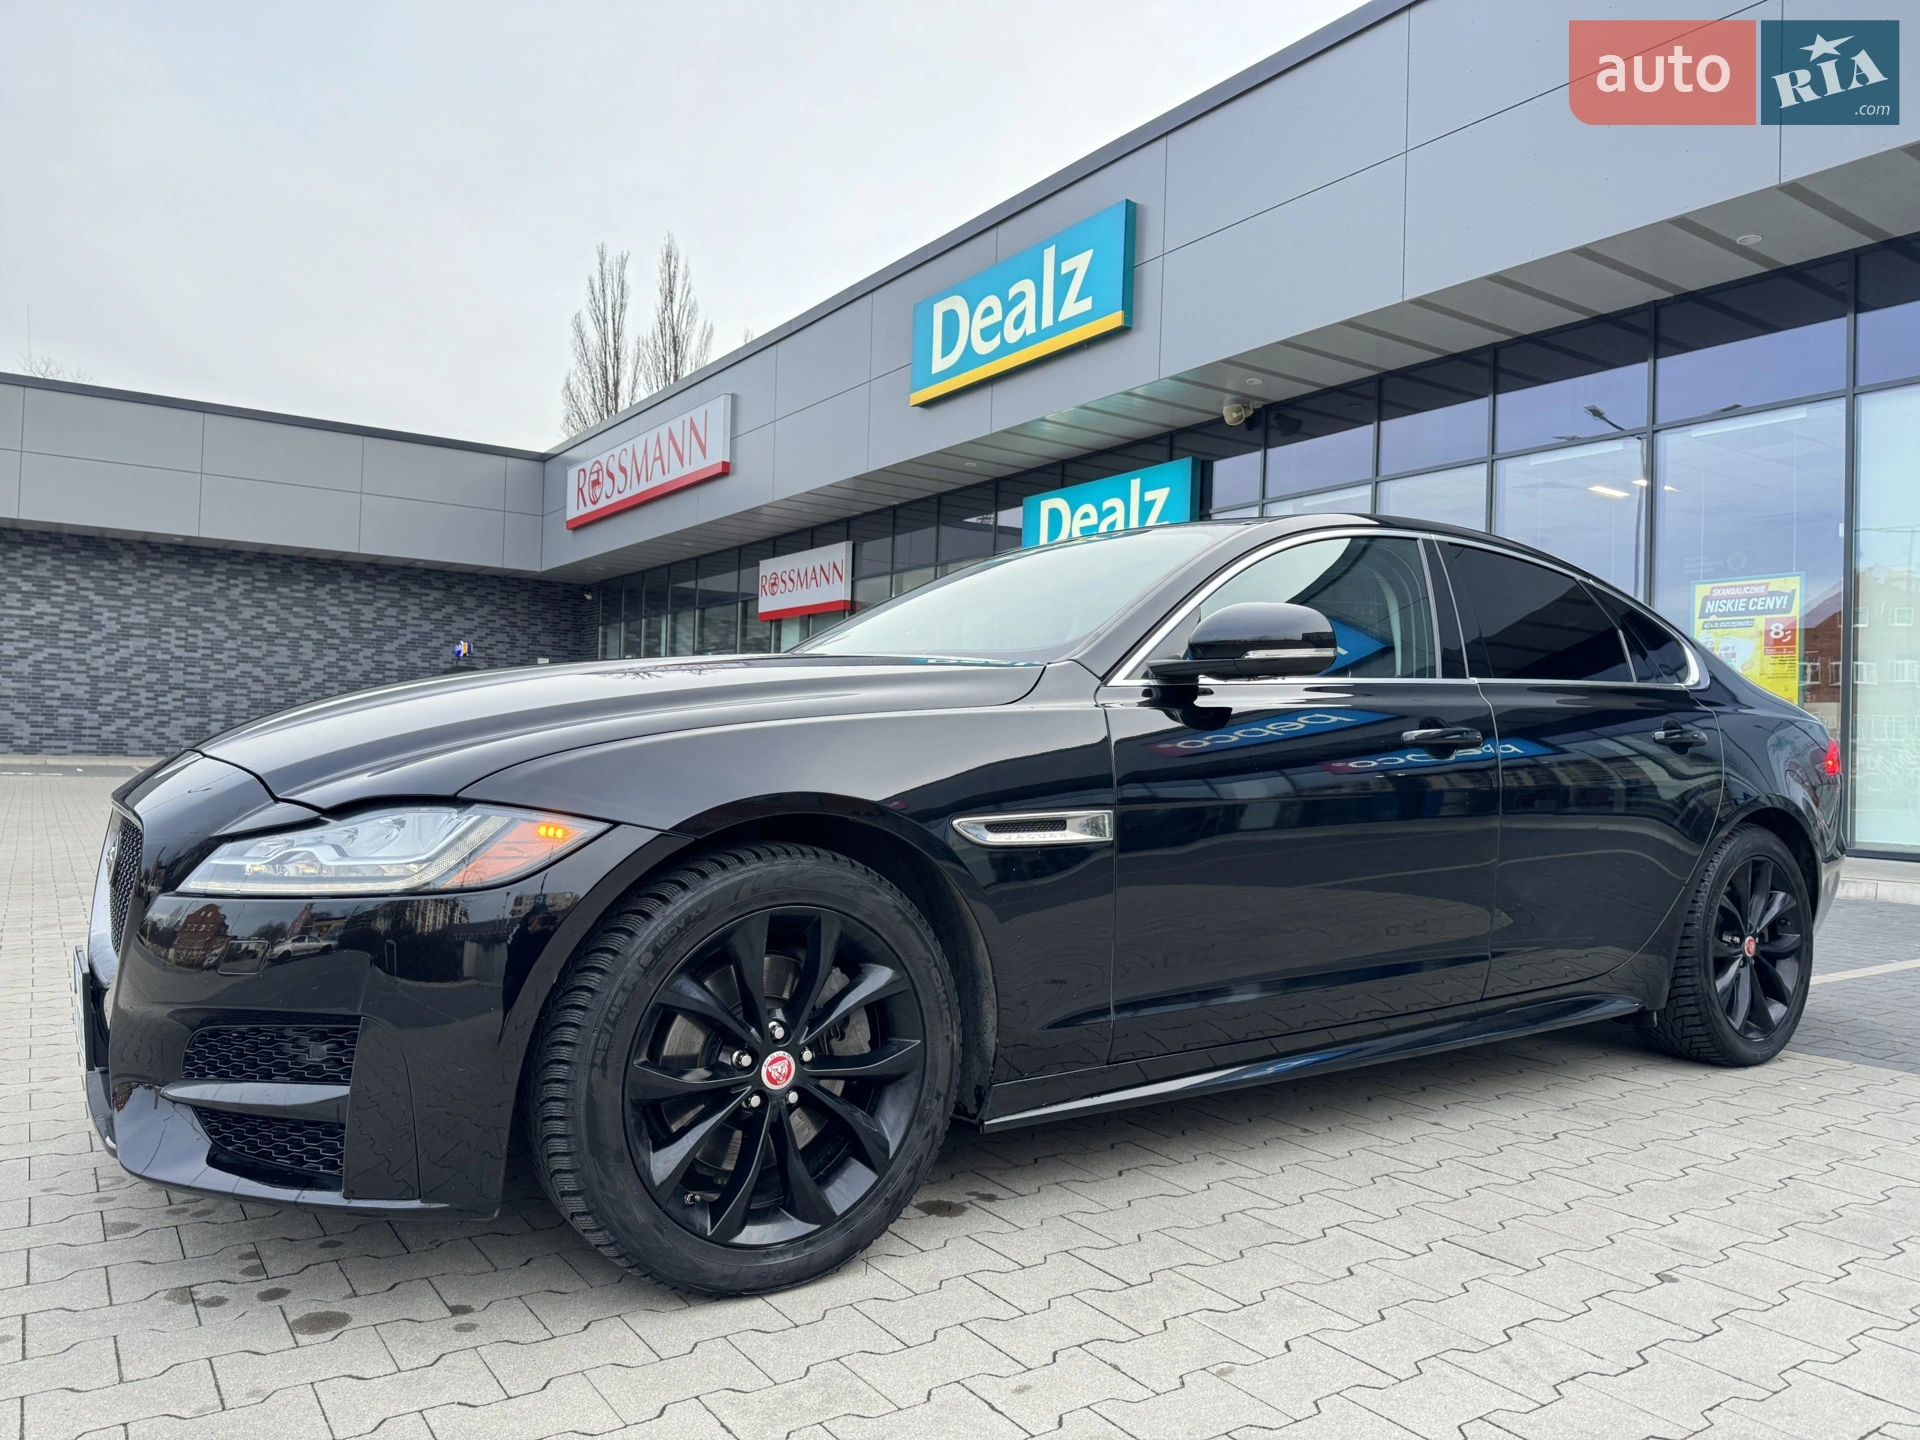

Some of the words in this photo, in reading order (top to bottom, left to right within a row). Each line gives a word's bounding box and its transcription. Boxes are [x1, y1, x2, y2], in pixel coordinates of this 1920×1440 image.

[931, 243, 1094, 375] Dealz
[576, 409, 708, 510] ROSSMANN
[1038, 477, 1171, 546] Dealz
[760, 558, 844, 598] ROSSMANN
[1705, 598, 1746, 614] NISKIE
[1748, 595, 1788, 611] CENY!
[1712, 585, 1767, 596] SKANDALICZNIE
